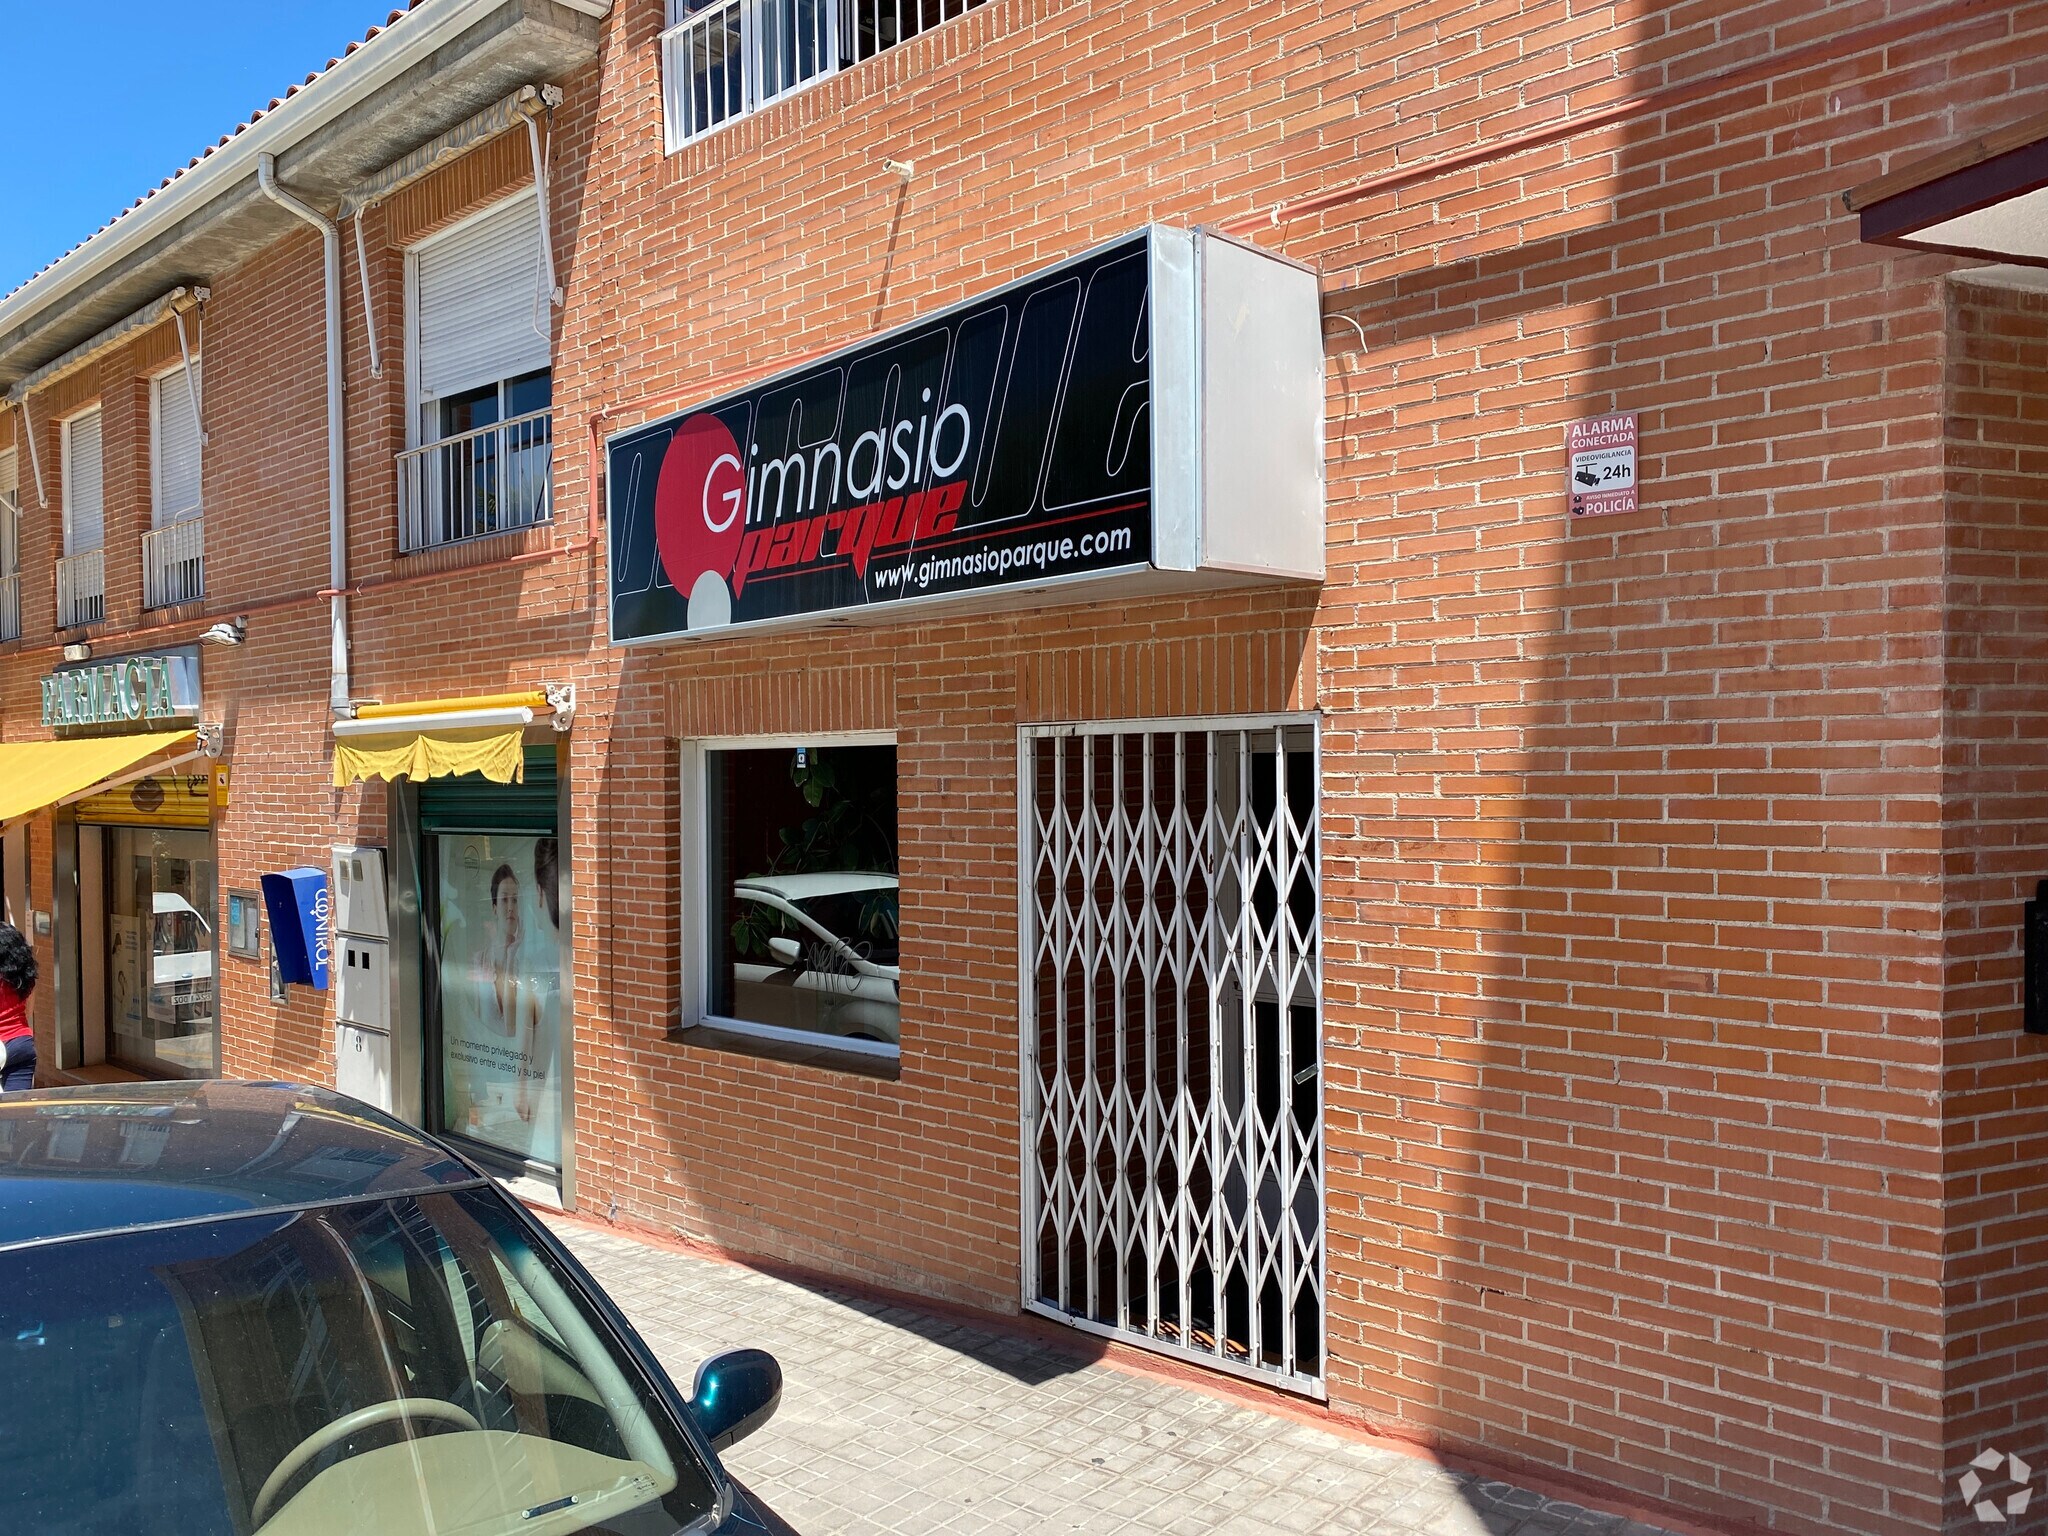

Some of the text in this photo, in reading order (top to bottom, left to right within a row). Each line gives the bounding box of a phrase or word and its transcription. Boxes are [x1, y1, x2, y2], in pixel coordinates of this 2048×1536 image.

[1571, 416, 1634, 438] ALARMA
[1571, 431, 1634, 449] CONECTADA
[702, 387, 970, 532] Gimnasio
[1575, 449, 1632, 462] VIDEOVIGILANCIA
[1603, 464, 1631, 480] 24h
[1586, 497, 1635, 515] POLICÍA
[1602, 490, 1630, 499] INMEDIATO
[731, 480, 968, 600] parque
[875, 526, 1132, 589] www.gimnasioparque.com
[40, 656, 175, 726] FARMACIA
[450, 1036, 533, 1065] Un momento privilegiado y
[450, 1051, 546, 1081] exclusivo entre usted y su piel
